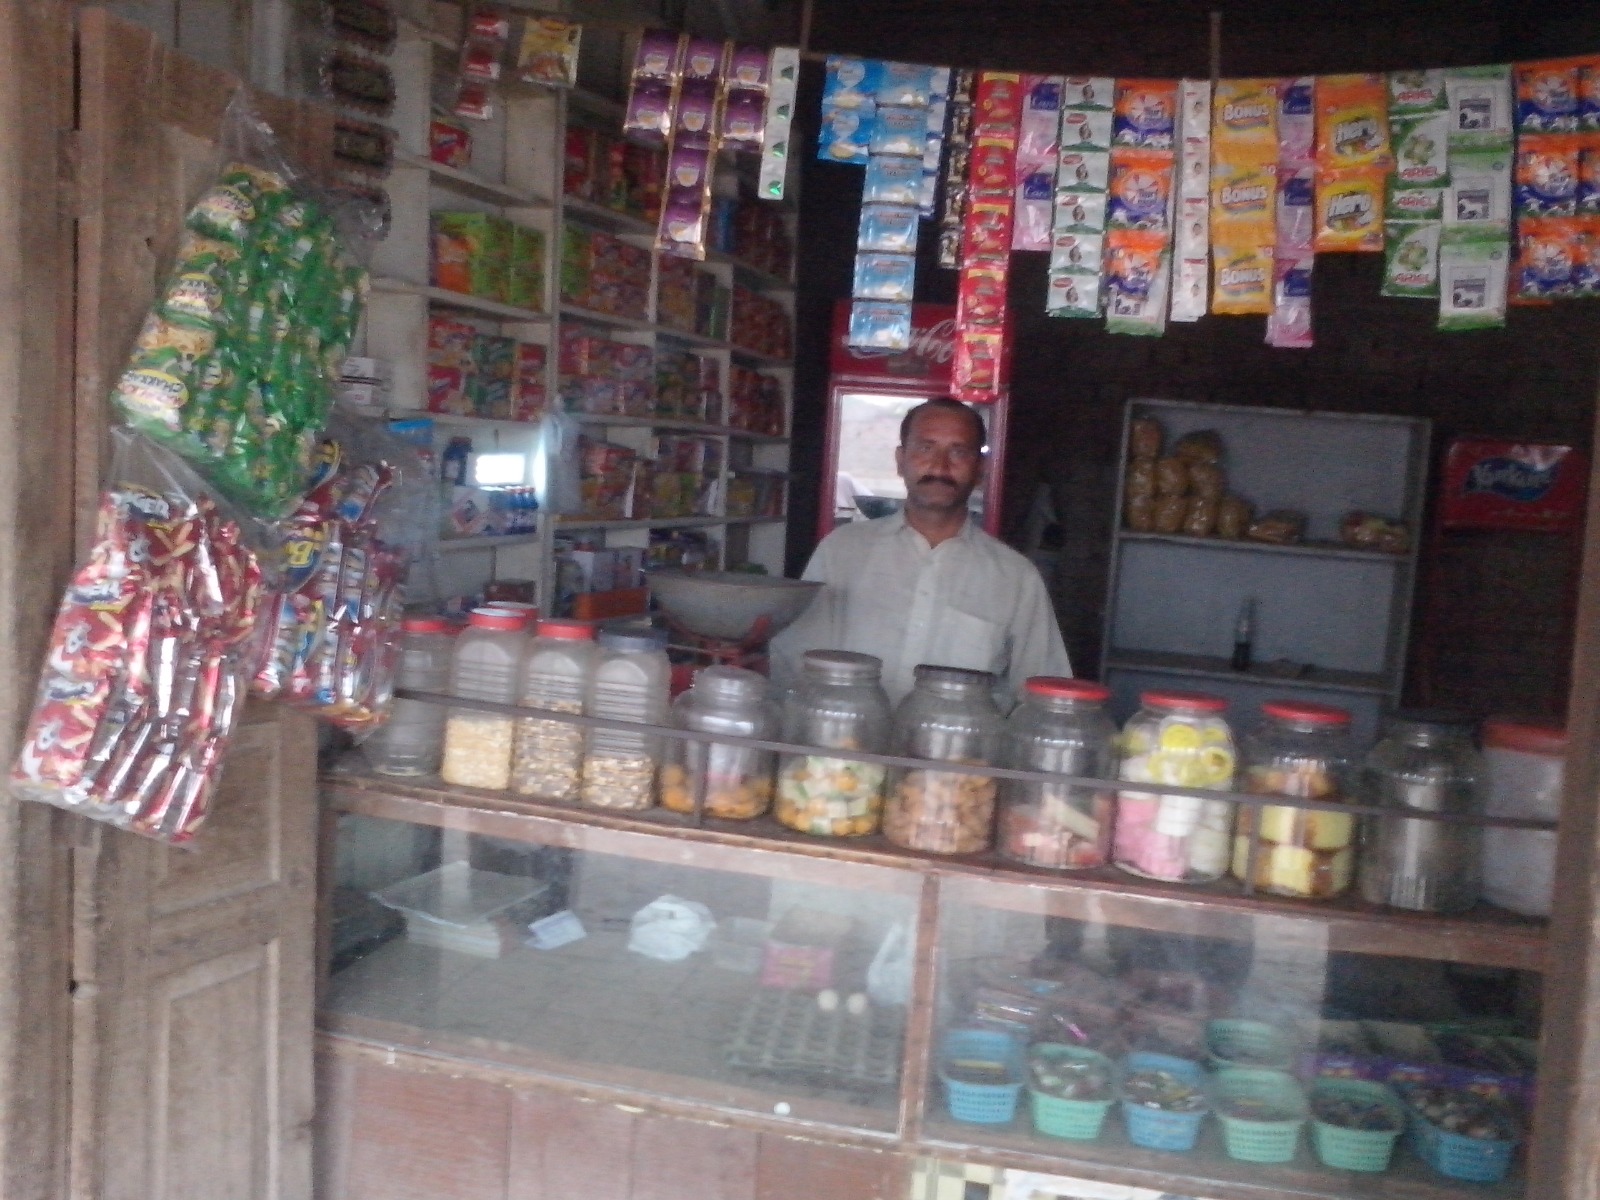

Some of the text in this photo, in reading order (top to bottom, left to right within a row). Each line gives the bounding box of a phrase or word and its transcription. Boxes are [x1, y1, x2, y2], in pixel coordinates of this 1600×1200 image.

[1399, 89, 1434, 101] ARIEL
[1223, 103, 1269, 121] BONUS
[1401, 165, 1438, 179] ARIEL
[1221, 185, 1267, 203] BONUS
[1398, 196, 1433, 208] ARIEL
[1328, 194, 1372, 218] Hero
[1220, 267, 1265, 286] BONUS
[1394, 272, 1431, 285] ARIEL
